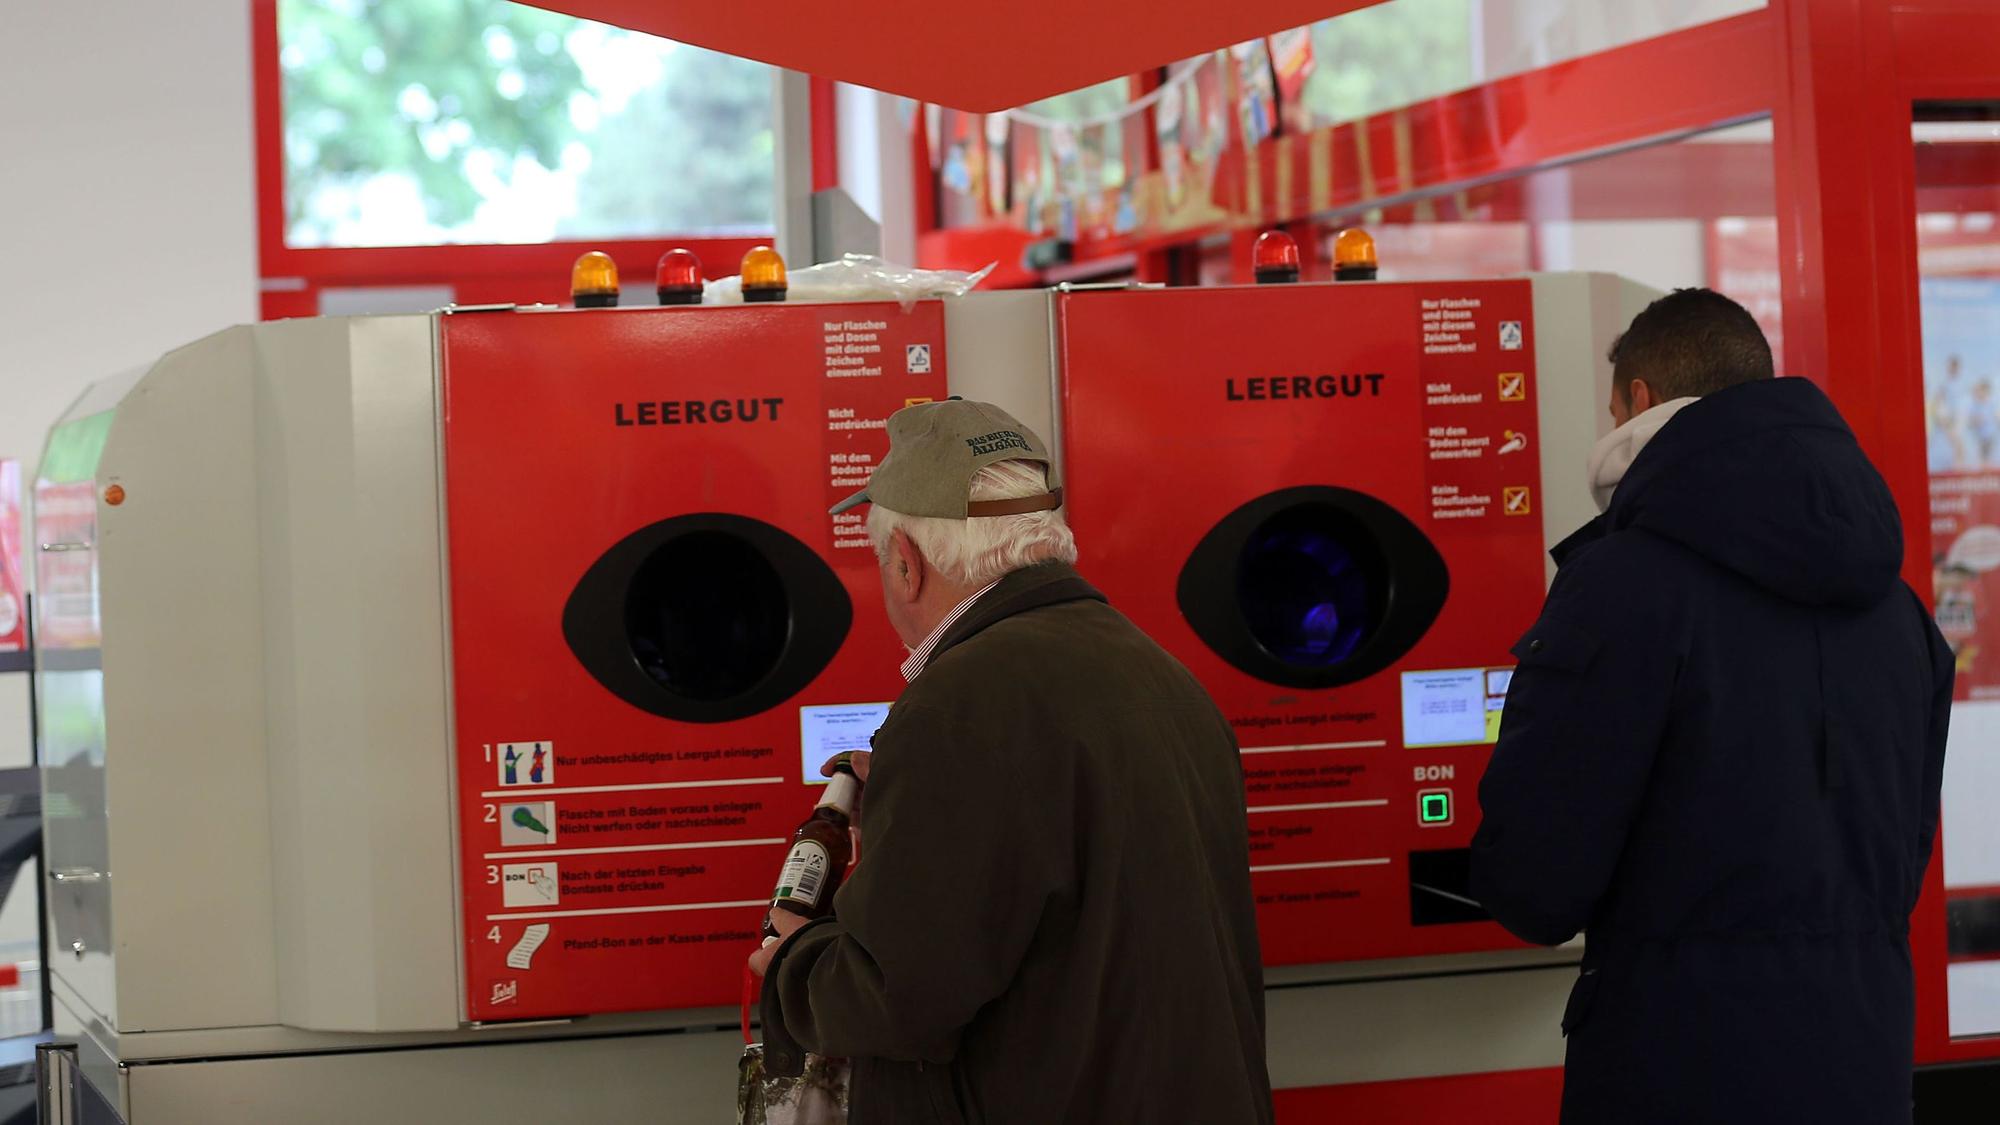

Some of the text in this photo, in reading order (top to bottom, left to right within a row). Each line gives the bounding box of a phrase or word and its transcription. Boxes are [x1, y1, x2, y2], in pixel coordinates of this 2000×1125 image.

[1422, 298, 1481, 309] Nur Flaschen
[1423, 310, 1472, 321] und Dosen
[824, 320, 887, 331] Nur Flaschen
[1423, 321, 1476, 331] mit diesem
[825, 333, 878, 343] und Dosen
[1424, 333, 1460, 343] Zeichen
[825, 344, 881, 354] mit diesem
[1424, 343, 1477, 354] einwerfen!
[825, 356, 864, 366] Zeichen
[826, 367, 882, 378] einwerfen!
[1226, 374, 1385, 401] LEERGUT
[1426, 384, 1451, 393] Nicht
[1427, 393, 1482, 405] zerdrücken!
[615, 398, 784, 427] LEERGUT
[828, 408, 854, 418] Nicht
[1429, 426, 1467, 437] Mit dem
[966, 436, 987, 447] DAS
[1430, 437, 1490, 448] Boden zuerst
[830, 453, 871, 463] Mit dem
[1430, 448, 1482, 459] einwerfen!
[831, 465, 863, 475] Boden
[831, 477, 870, 487] einwerf
[1432, 485, 1458, 495] Keine
[1432, 495, 1491, 506] Glasflaschen
[833, 513, 861, 523] Keine
[1432, 507, 1485, 518] einwerfen!
[1285, 713, 1328, 726] Leergut
[1330, 710, 1377, 724] einlegen
[483, 744, 491, 762] 1
[556, 746, 774, 766] Nur unbeschädigtes Leergut einlegen
[1413, 764, 1454, 781] BON
[483, 803, 497, 823] 2
[559, 801, 763, 820] Flasche mit Boden voraus einlegen
[559, 815, 747, 834] Nicht werfen oder nachschieben
[486, 865, 526, 884] 3 BON
[561, 864, 706, 882] Nach der letzten Eingabe
[561, 880, 665, 895] Bontaste drücken
[486, 925, 502, 944] 4
[563, 937, 626, 950] Pfand-Bon
[628, 938, 644, 947] an
[647, 934, 666, 946] der
[668, 932, 705, 944] Kasse
